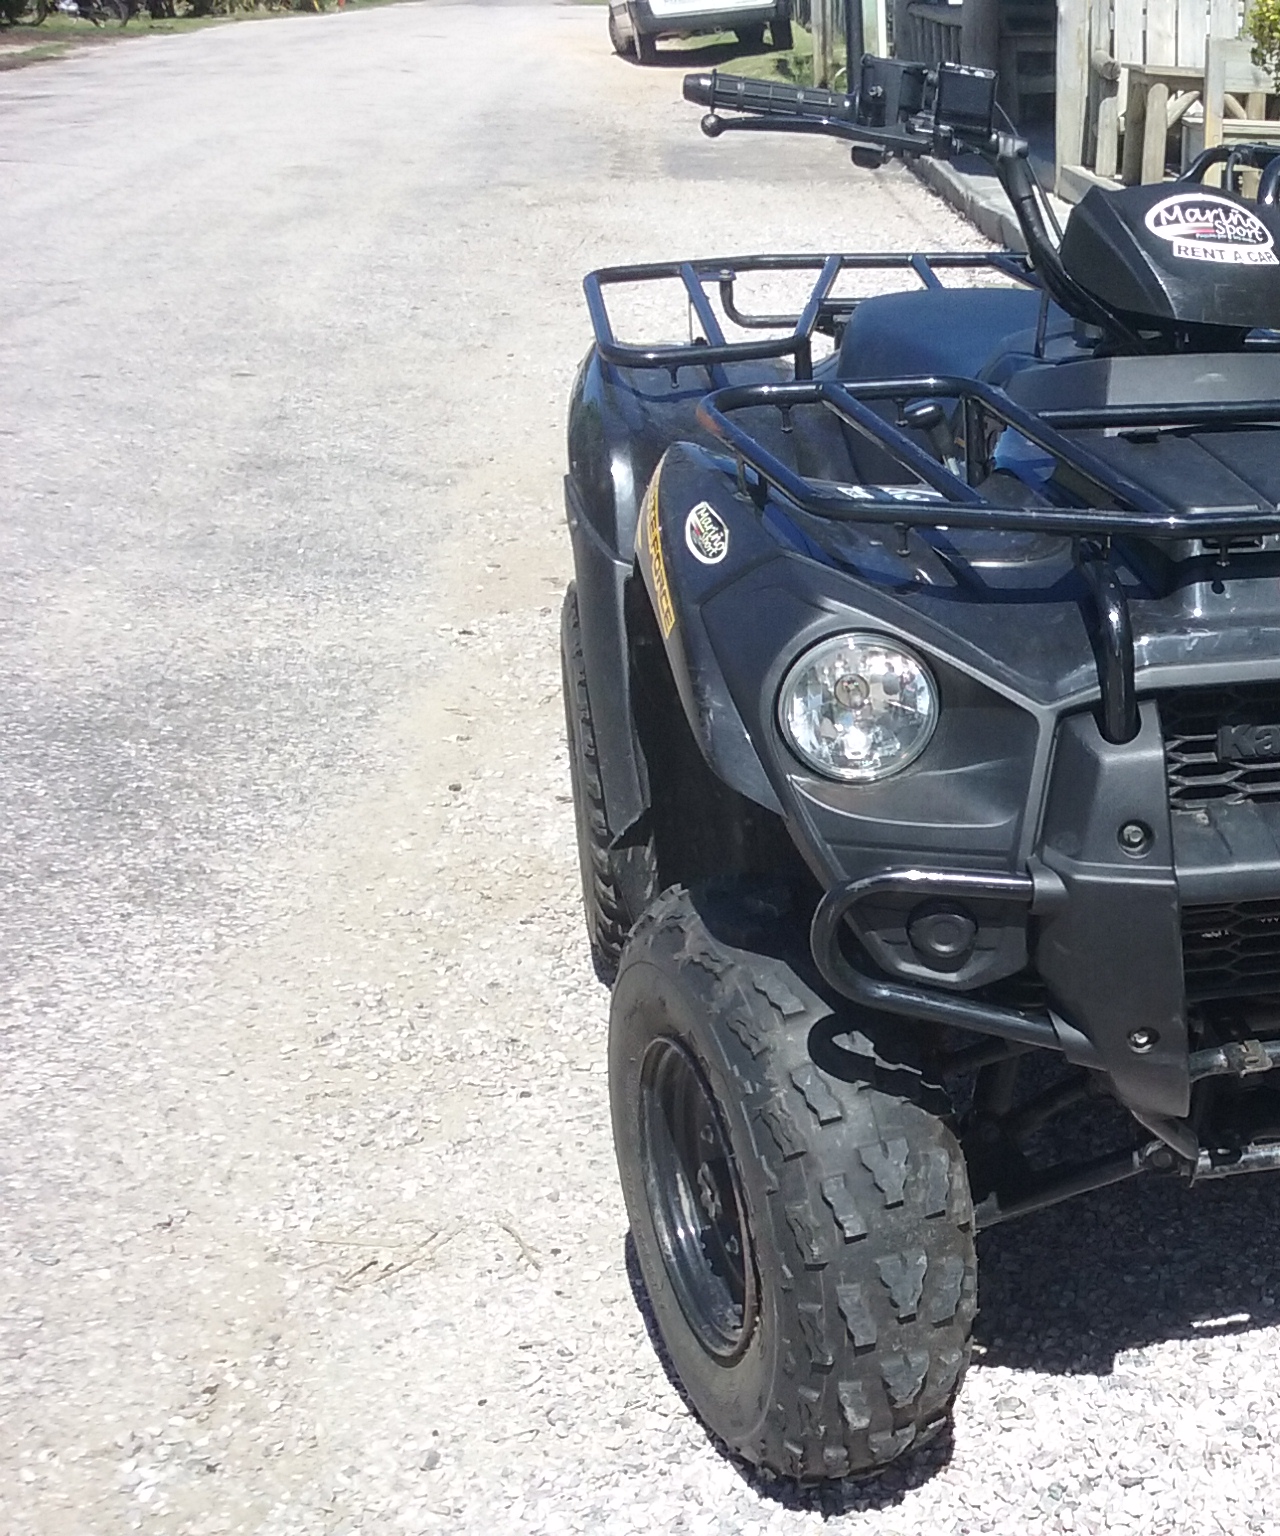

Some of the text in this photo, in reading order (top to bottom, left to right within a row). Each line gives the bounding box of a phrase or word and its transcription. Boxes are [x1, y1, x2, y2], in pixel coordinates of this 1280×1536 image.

[1214, 219, 1263, 242] Sport
[1177, 244, 1277, 263] RENT A CAR
